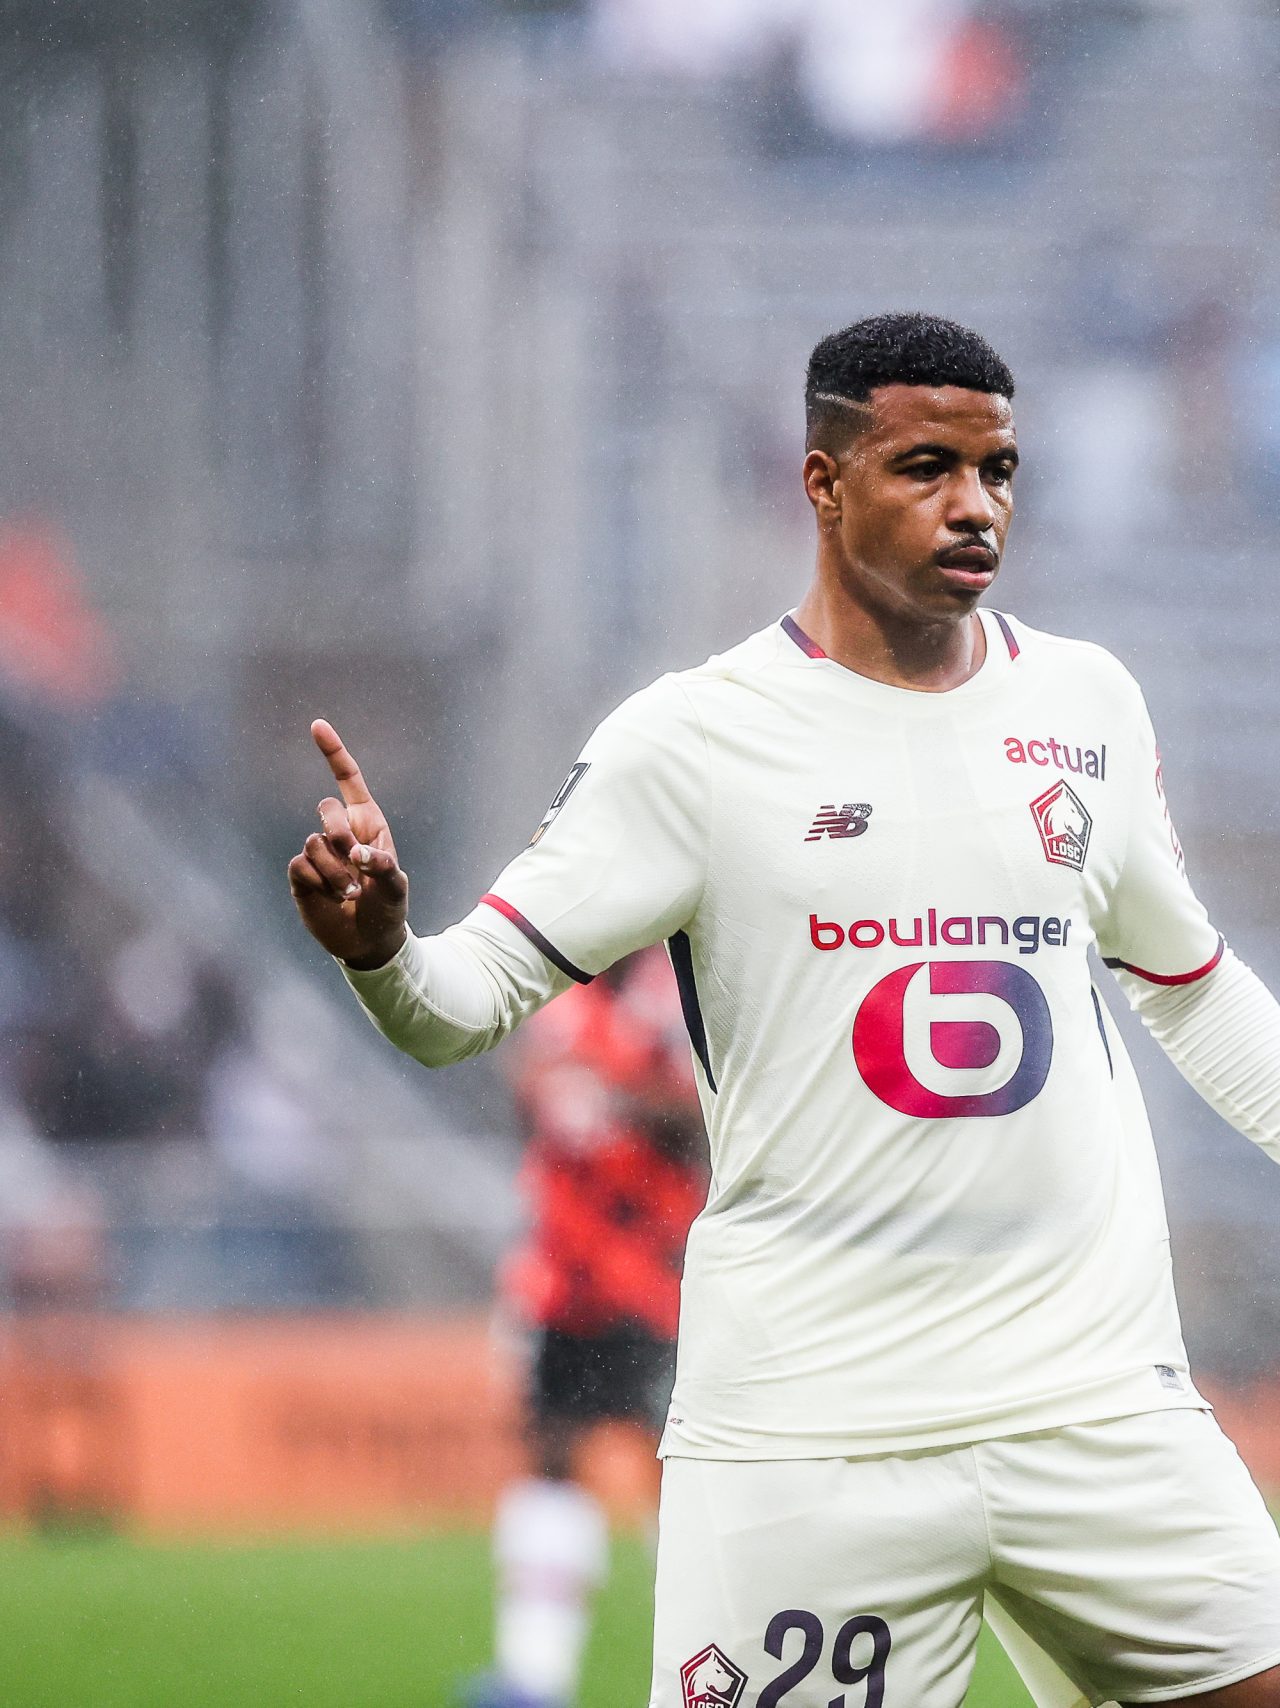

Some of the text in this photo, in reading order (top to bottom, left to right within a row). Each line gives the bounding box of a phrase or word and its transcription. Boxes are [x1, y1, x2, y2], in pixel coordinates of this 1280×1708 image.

[1003, 737, 1107, 781] actual
[1052, 839, 1081, 860] LOSC
[809, 908, 1072, 954] boulanger
[756, 1609, 892, 1708] 29
